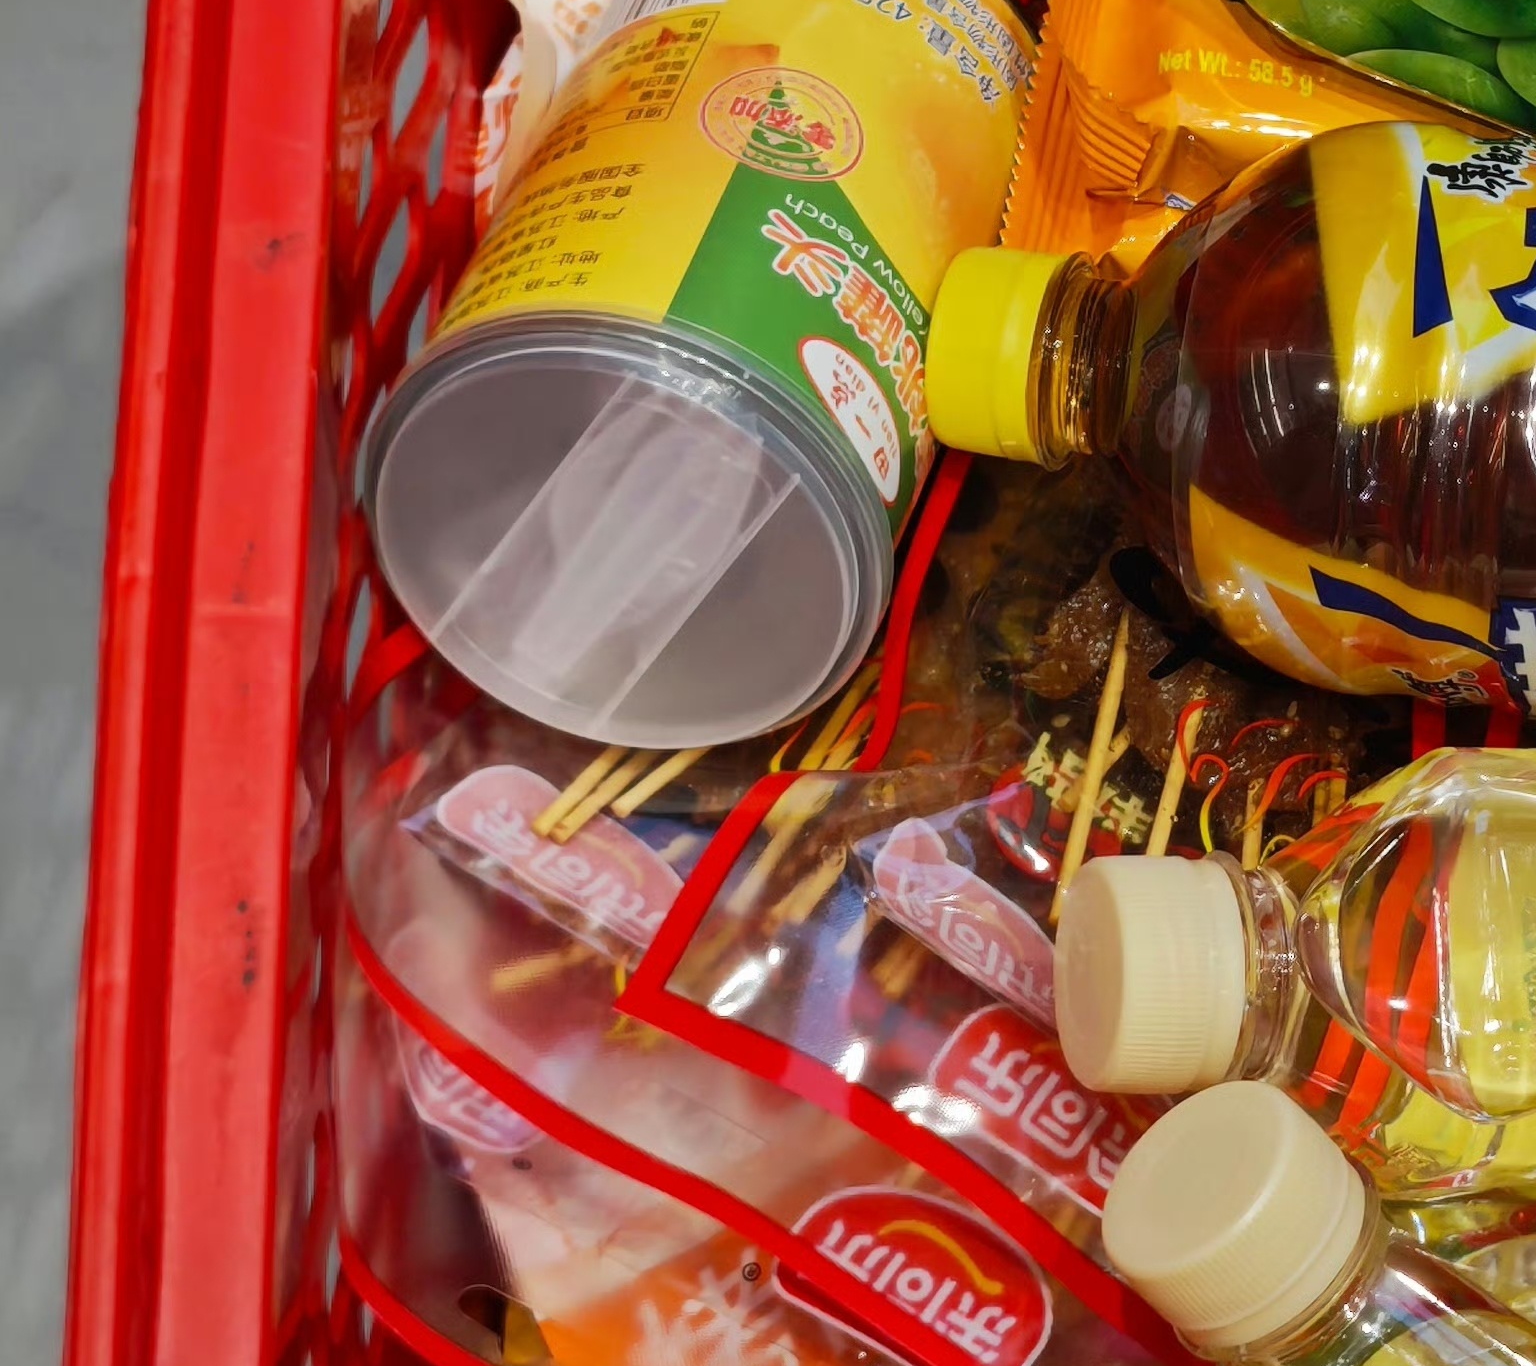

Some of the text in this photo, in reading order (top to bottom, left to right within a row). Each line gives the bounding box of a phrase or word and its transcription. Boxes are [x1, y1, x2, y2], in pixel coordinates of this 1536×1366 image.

[1158, 48, 1192, 74] Net
[1248, 58, 1294, 89] 58.5
[783, 192, 873, 262] Peach
